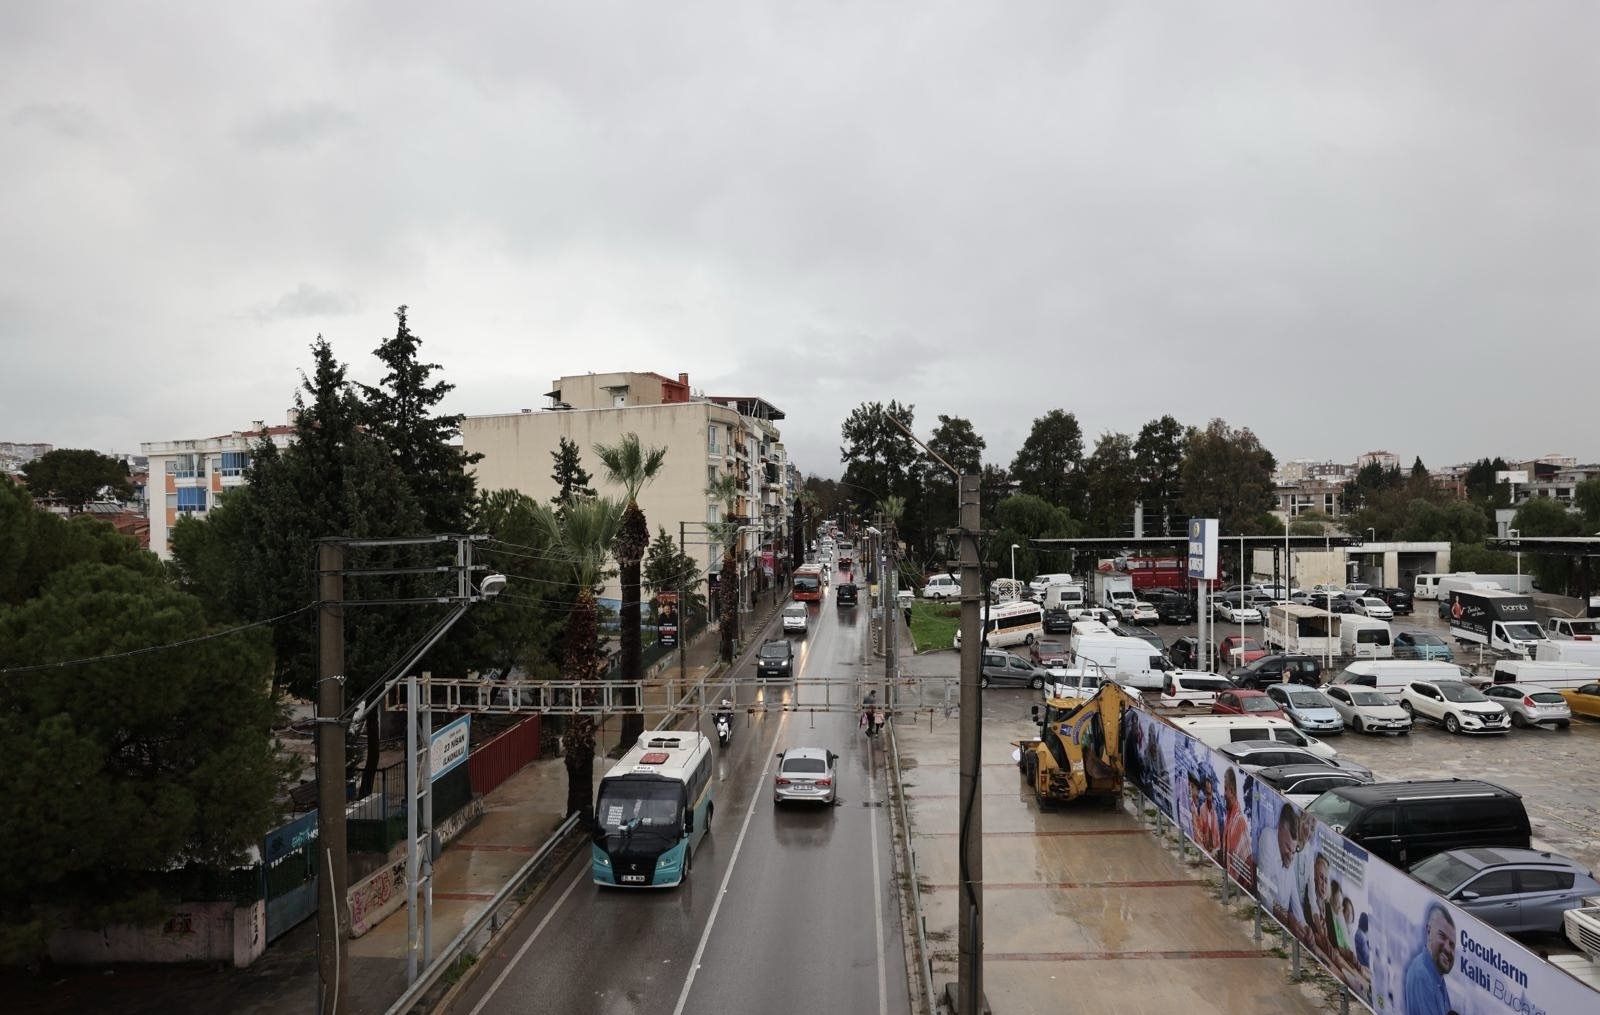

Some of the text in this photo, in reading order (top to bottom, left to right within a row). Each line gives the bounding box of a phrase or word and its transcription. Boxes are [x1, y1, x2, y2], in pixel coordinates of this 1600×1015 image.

[1501, 603, 1528, 611] bambi
[443, 742, 450, 753] 23
[1460, 930, 1528, 989] Çocukların
[1460, 956, 1491, 992] Kalbi
